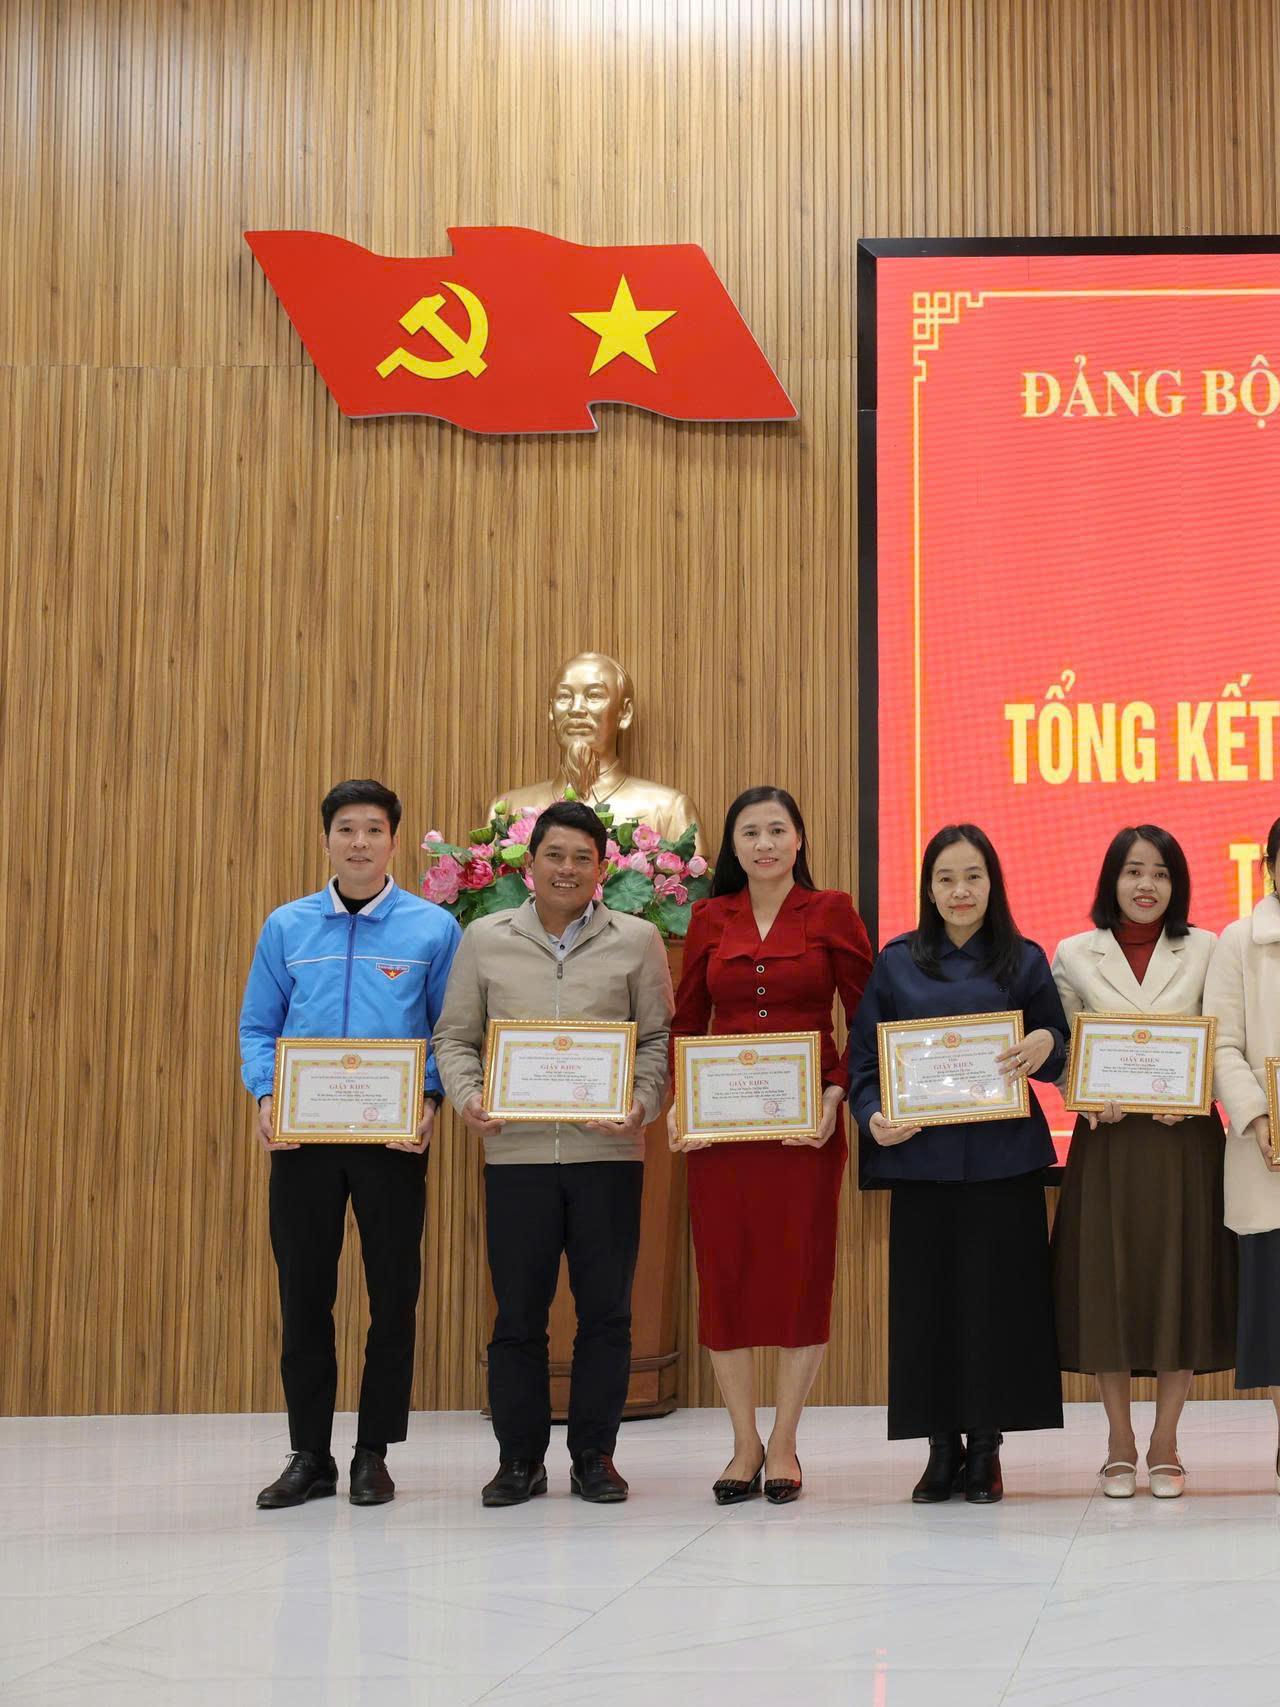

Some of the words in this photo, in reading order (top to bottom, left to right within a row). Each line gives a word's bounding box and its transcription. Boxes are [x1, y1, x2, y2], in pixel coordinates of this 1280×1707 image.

[1020, 354, 1186, 418] ĐẢNG
[1004, 669, 1157, 785] TỔNG
[1177, 673, 1280, 782] KẾT
